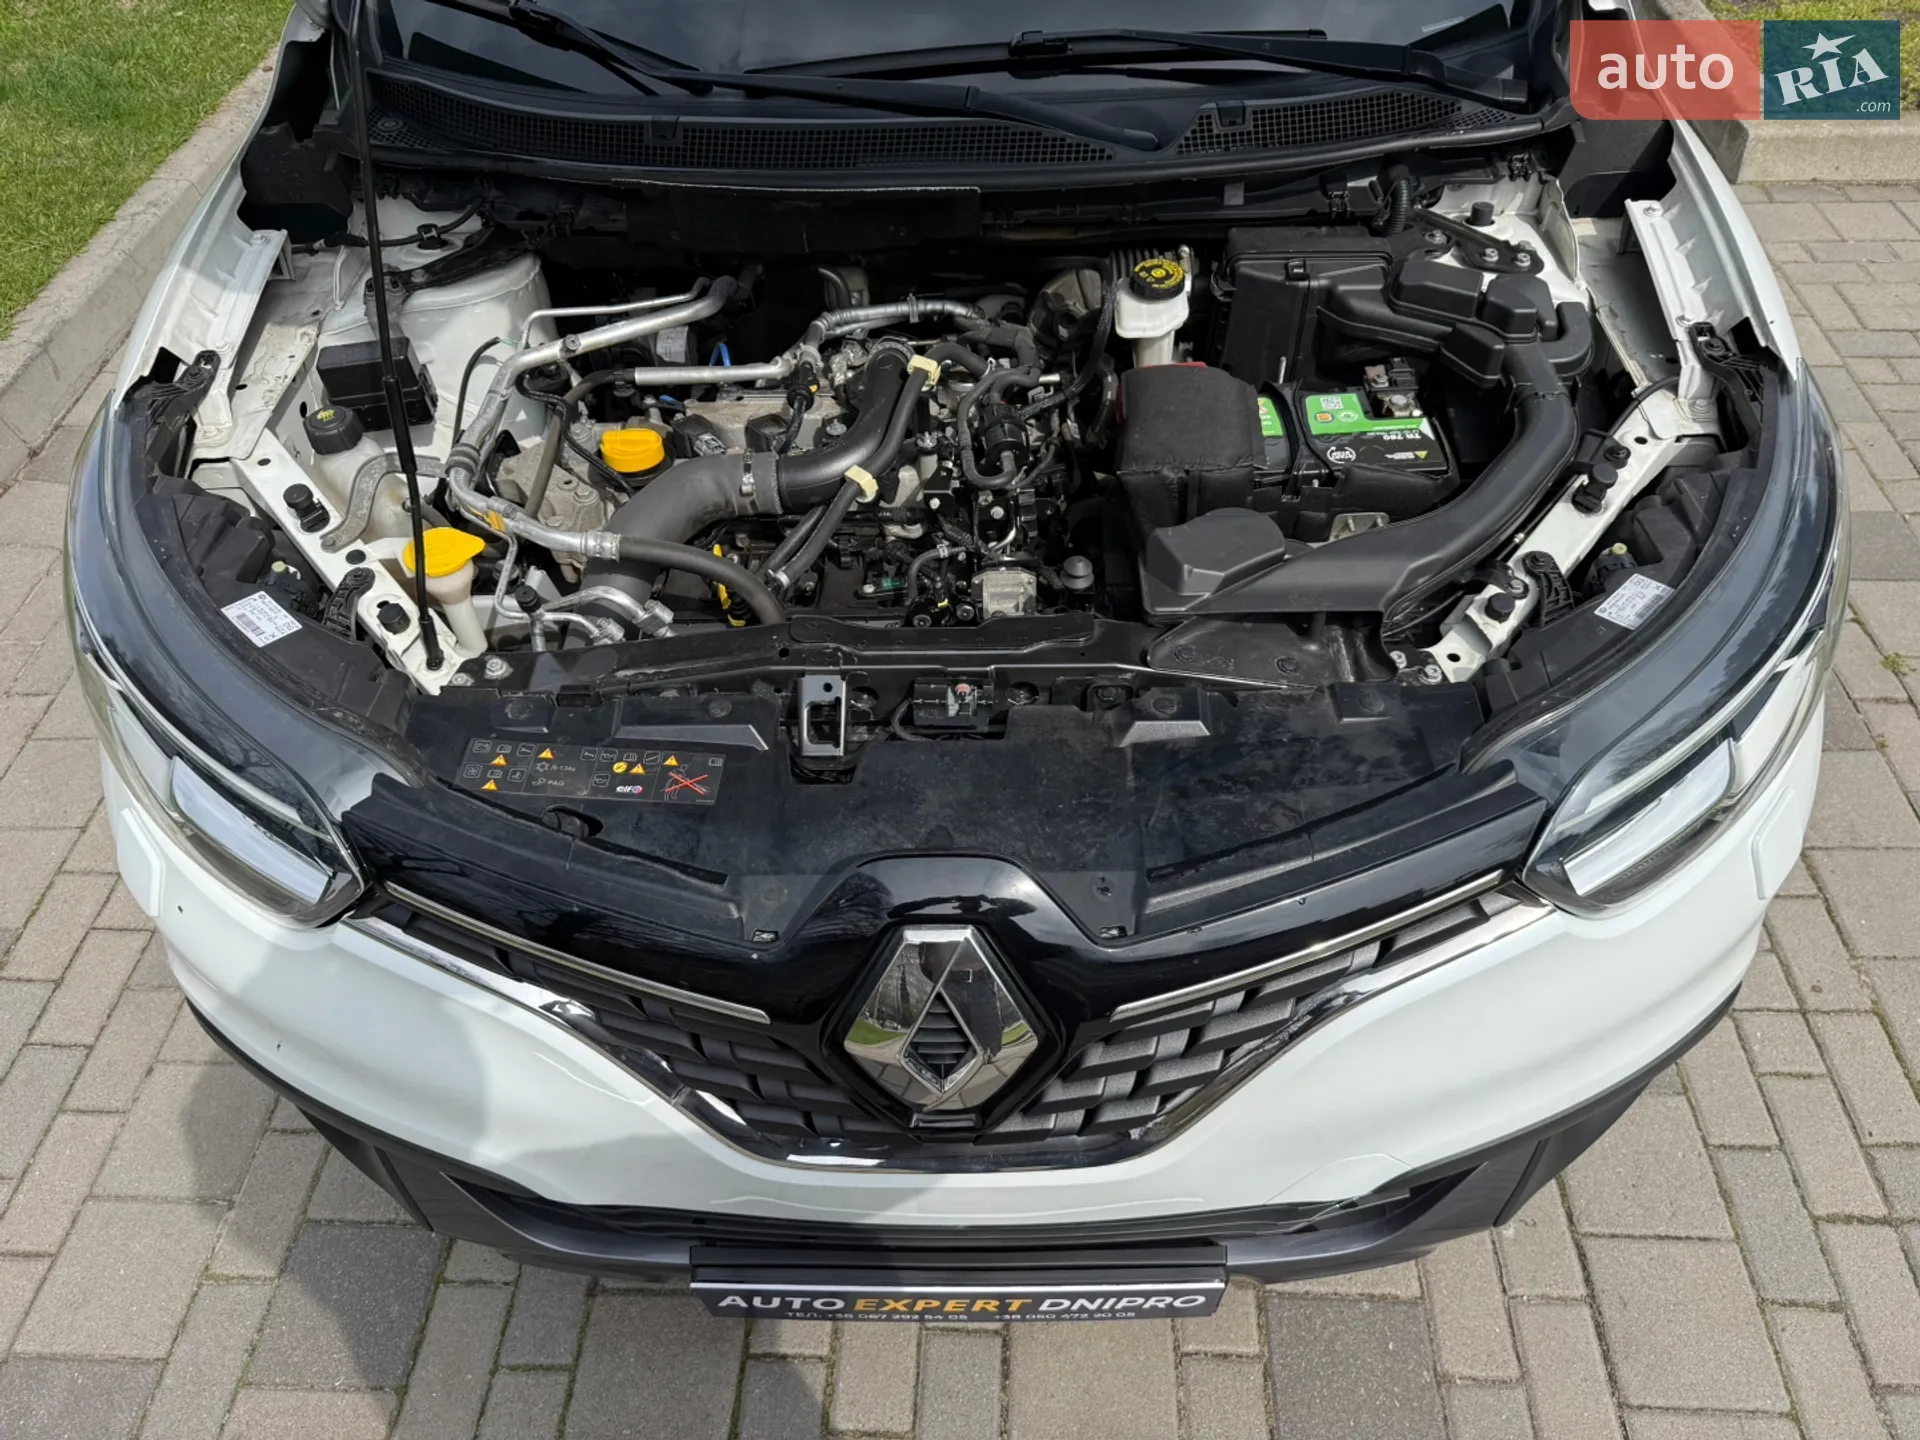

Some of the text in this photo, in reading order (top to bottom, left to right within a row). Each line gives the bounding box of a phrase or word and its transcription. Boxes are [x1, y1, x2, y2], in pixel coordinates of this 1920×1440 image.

[615, 785, 633, 794] elf
[717, 1295, 1206, 1312] AUTO EXPERT DNIPRO
